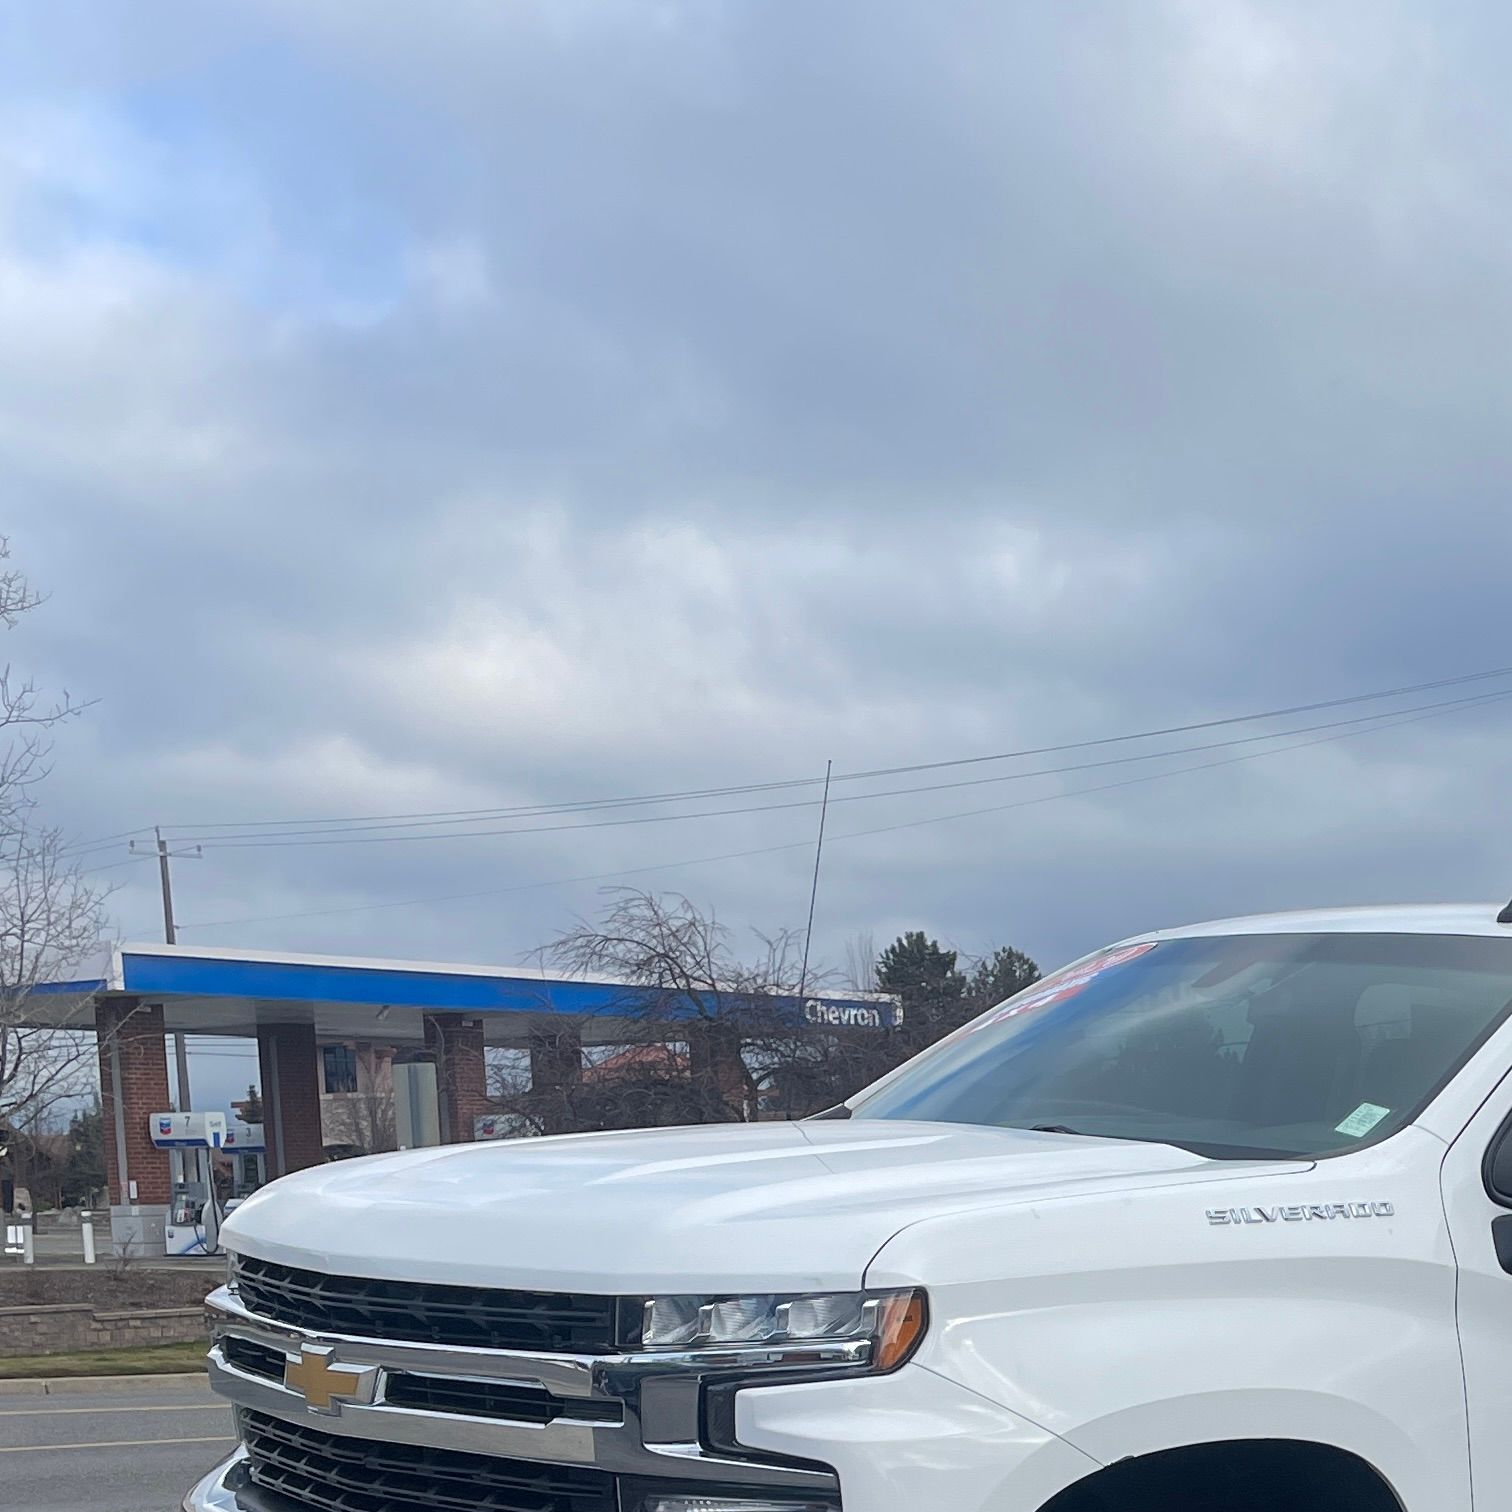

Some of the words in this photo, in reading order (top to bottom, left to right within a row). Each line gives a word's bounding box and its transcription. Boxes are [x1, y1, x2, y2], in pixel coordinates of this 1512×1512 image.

[805, 999, 880, 1027] Chevron
[184, 1116, 191, 1127] 7
[1205, 1201, 1395, 1226] SILVERADO
